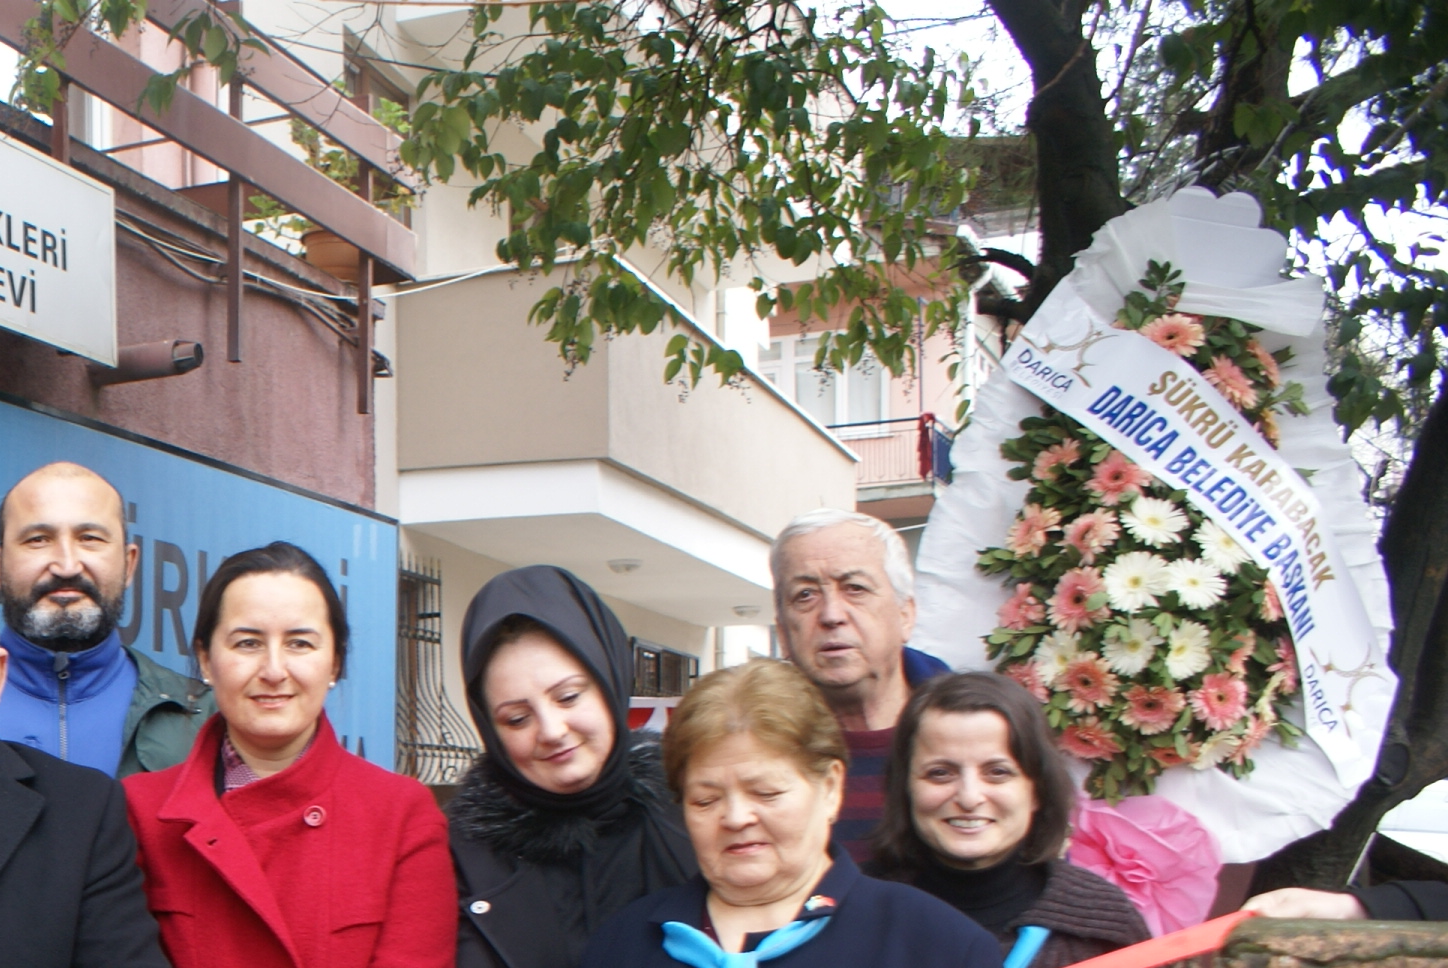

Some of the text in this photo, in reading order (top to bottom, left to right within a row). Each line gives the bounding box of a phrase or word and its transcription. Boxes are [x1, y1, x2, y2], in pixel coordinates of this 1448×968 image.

[1017, 348, 1074, 393] DARICA
[1086, 385, 1316, 642] DARICA BELEDİYE BAŞKANI
[1147, 370, 1335, 592] ŞÜKRÜ KARABACAK
[1304, 664, 1339, 734] DARICA
